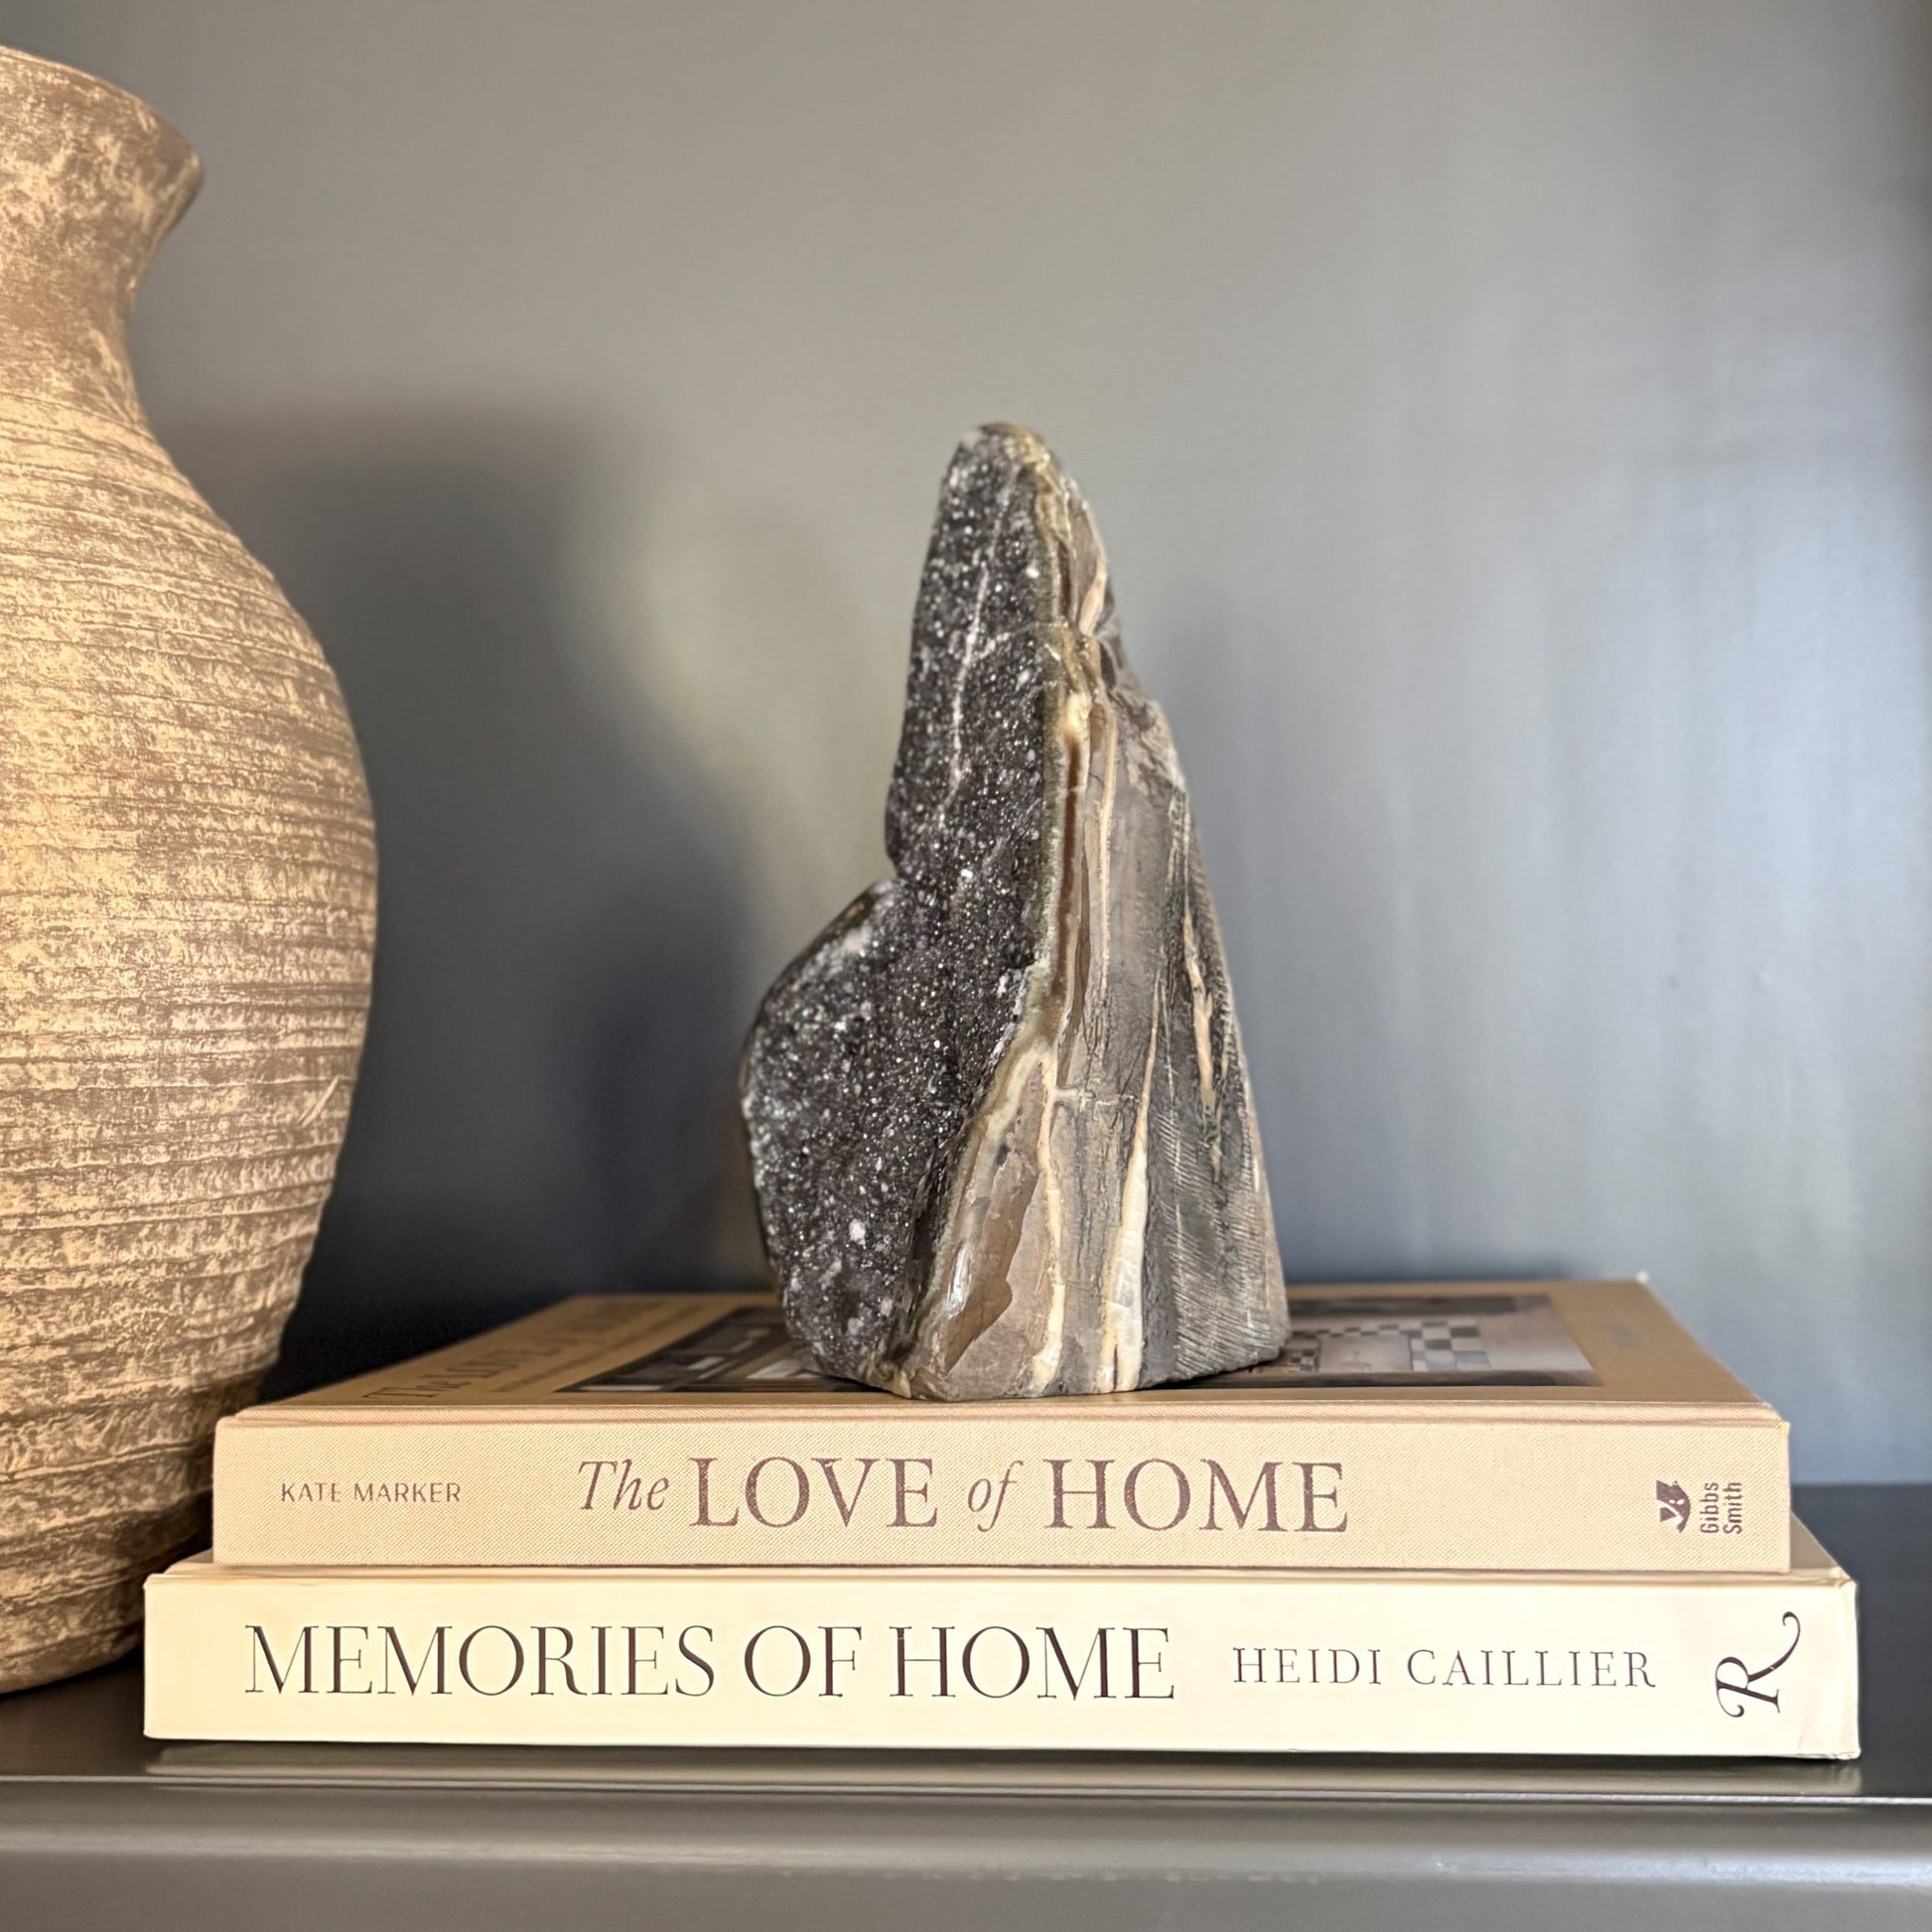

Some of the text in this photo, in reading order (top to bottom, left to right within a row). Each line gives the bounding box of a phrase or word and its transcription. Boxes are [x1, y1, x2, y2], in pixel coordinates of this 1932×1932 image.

[281, 1481, 462, 1504] KATE MARKER
[578, 1455, 1349, 1534] The LOVE of HOME
[1700, 1482, 1720, 1535] Gibbs
[1723, 1481, 1743, 1535] Smith
[244, 1624, 1175, 1701] MEMORIES OF HOME
[1233, 1646, 1657, 1689] HEIDI CAILLIER
